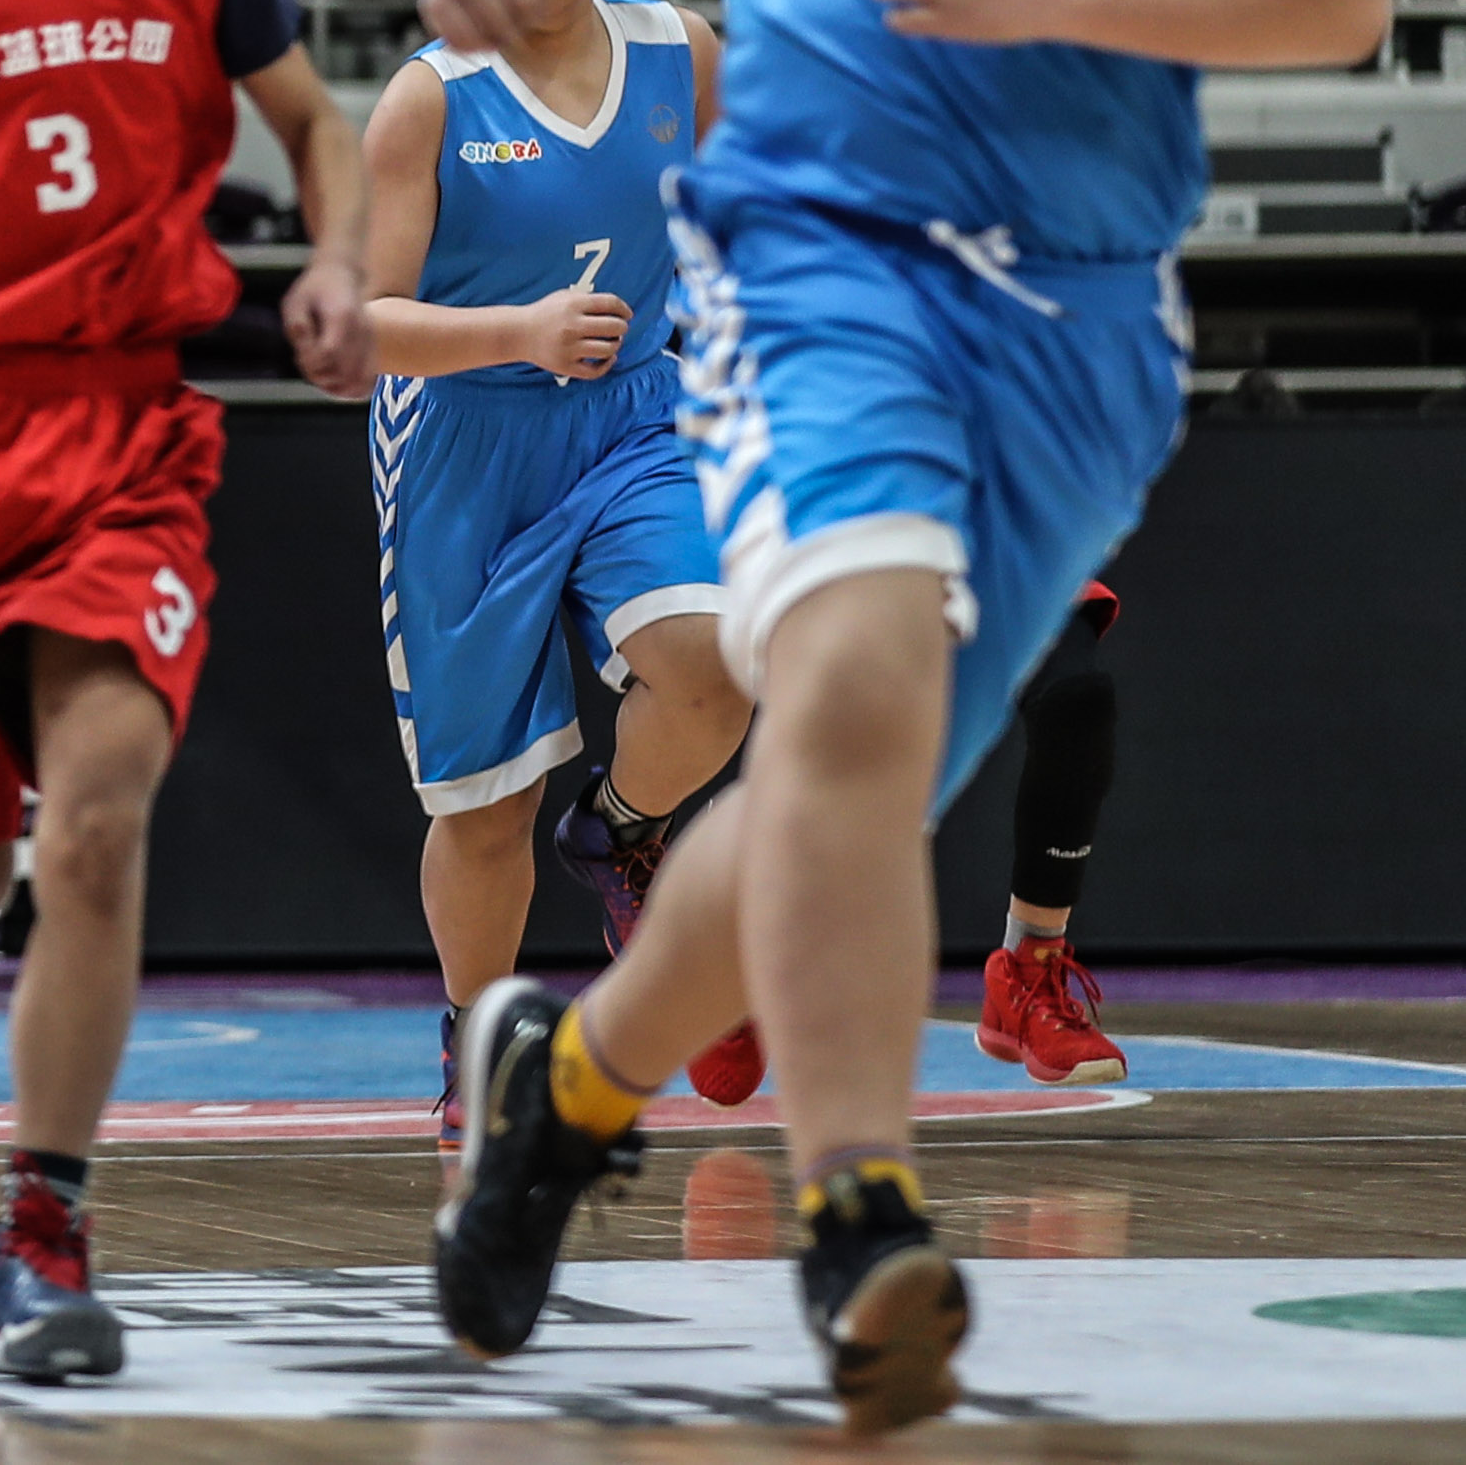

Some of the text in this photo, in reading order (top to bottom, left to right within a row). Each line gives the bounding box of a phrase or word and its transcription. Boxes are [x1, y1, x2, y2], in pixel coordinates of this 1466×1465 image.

[26, 112, 98, 214] 3
[570, 238, 612, 295] 7
[143, 565, 198, 658] 3
